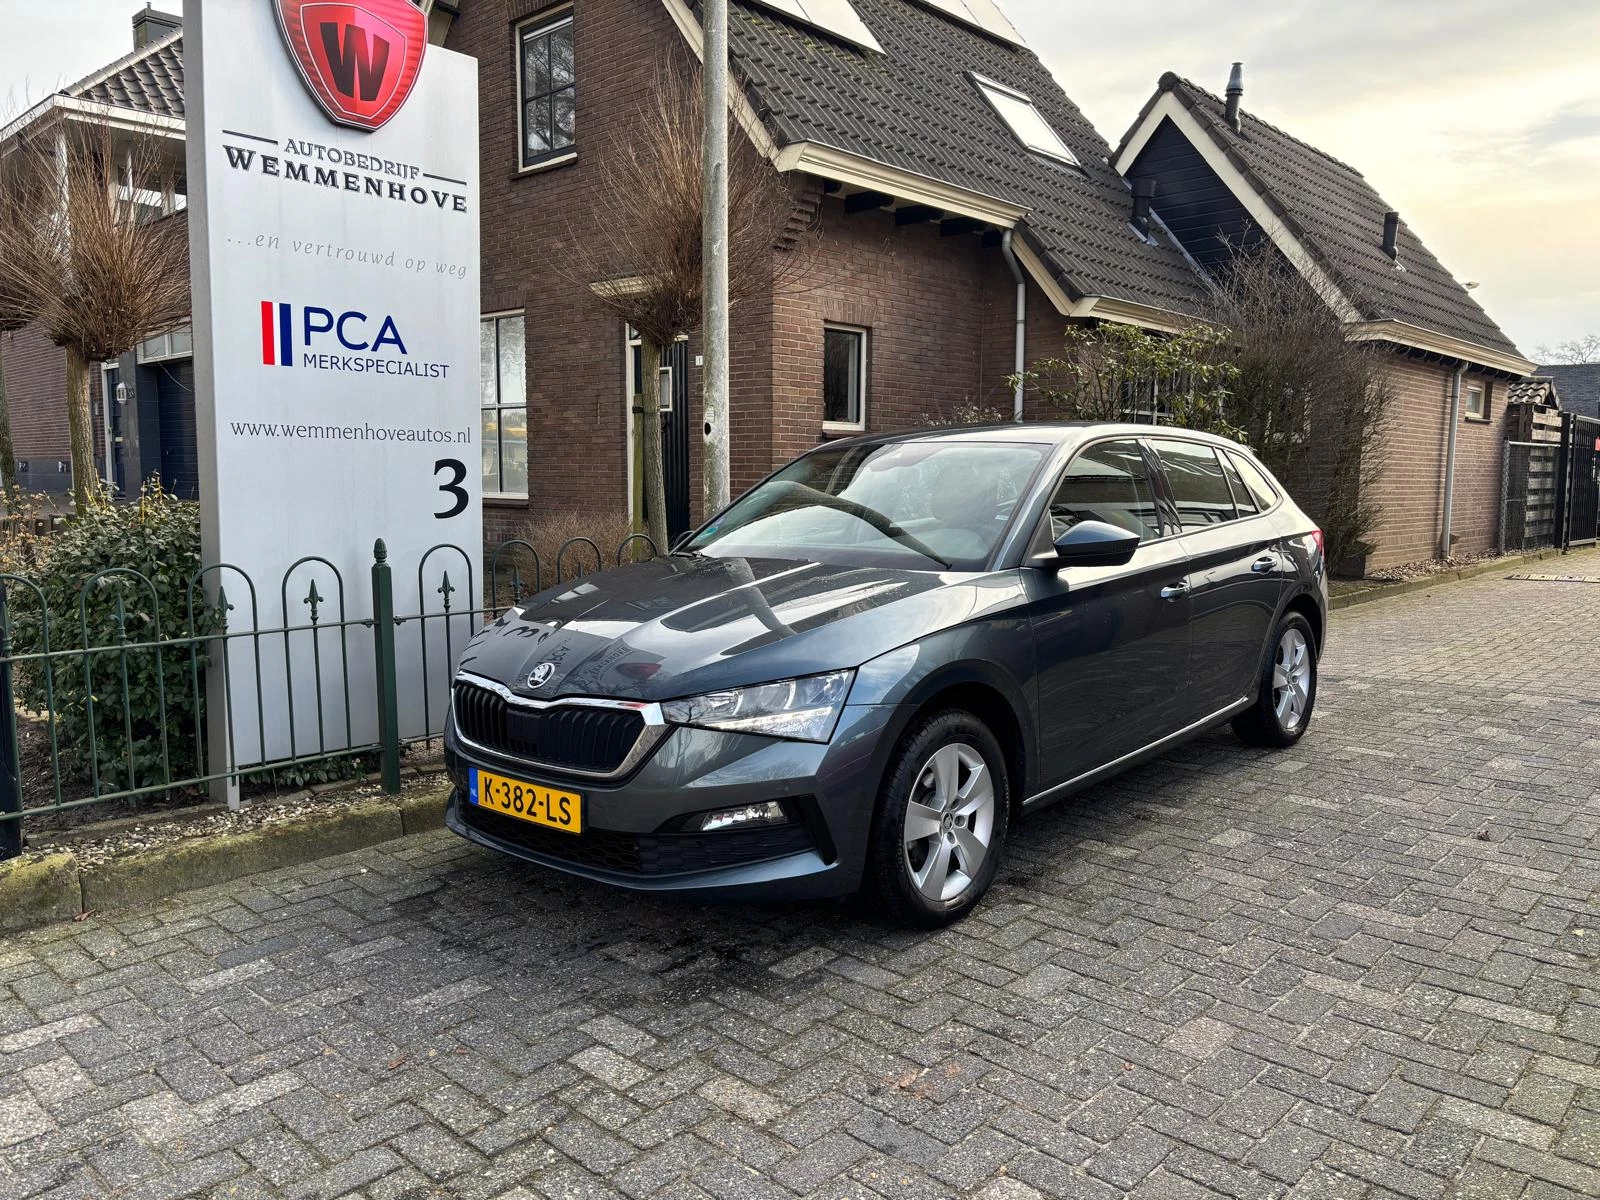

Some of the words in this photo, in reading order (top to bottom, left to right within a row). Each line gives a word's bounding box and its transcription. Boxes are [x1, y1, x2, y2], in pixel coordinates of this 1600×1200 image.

[320, 22, 390, 102] W
[222, 144, 467, 213] WEMMENHOVE
[284, 138, 420, 180] AUTOBEDRIJF
[292, 239, 395, 267] vertrouwd
[405, 256, 426, 273] op
[436, 260, 467, 280] weg
[303, 306, 408, 355] PCA
[303, 353, 449, 379] MERKSPECIALIST
[230, 421, 471, 444] www.wemmenhoveautos.nl
[433, 458, 470, 519] 3
[484, 777, 571, 826] K-382-LS
